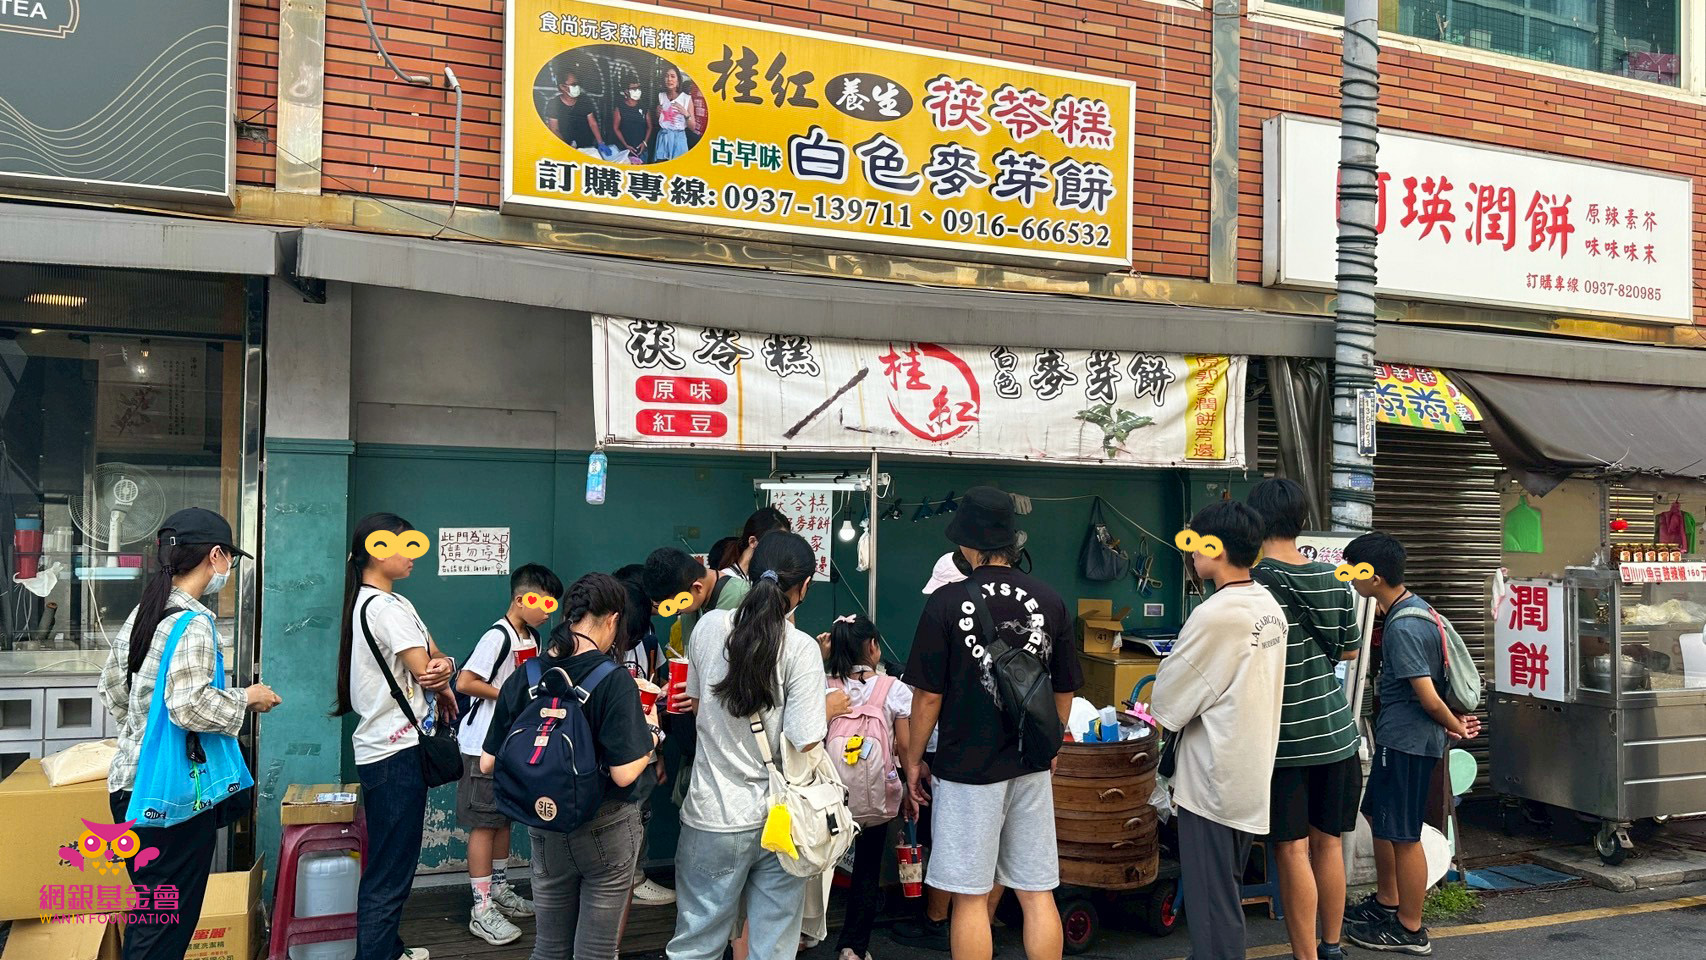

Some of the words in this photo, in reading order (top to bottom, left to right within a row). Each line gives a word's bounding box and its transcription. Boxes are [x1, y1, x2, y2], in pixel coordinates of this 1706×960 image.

[0, 0, 48, 20] TEA
[539, 11, 696, 54] 食尚玩家熱情推薦
[836, 77, 902, 117] 養生
[927, 79, 1114, 147] 茯苓糕
[711, 138, 782, 171] 古早味
[795, 131, 1114, 213] 白色麥芽餅
[942, 208, 1112, 248] 0916-666532
[1526, 272, 1580, 294] 訂購專線
[1584, 279, 1662, 301] 0937-820985
[626, 319, 820, 376] 茯苓糕
[652, 379, 713, 401] 原味
[1030, 349, 1176, 406] 麥芽餅
[652, 413, 713, 434] 紅豆
[447, 543, 506, 560] 請勿停車
[1508, 584, 1549, 692] 潤餅
